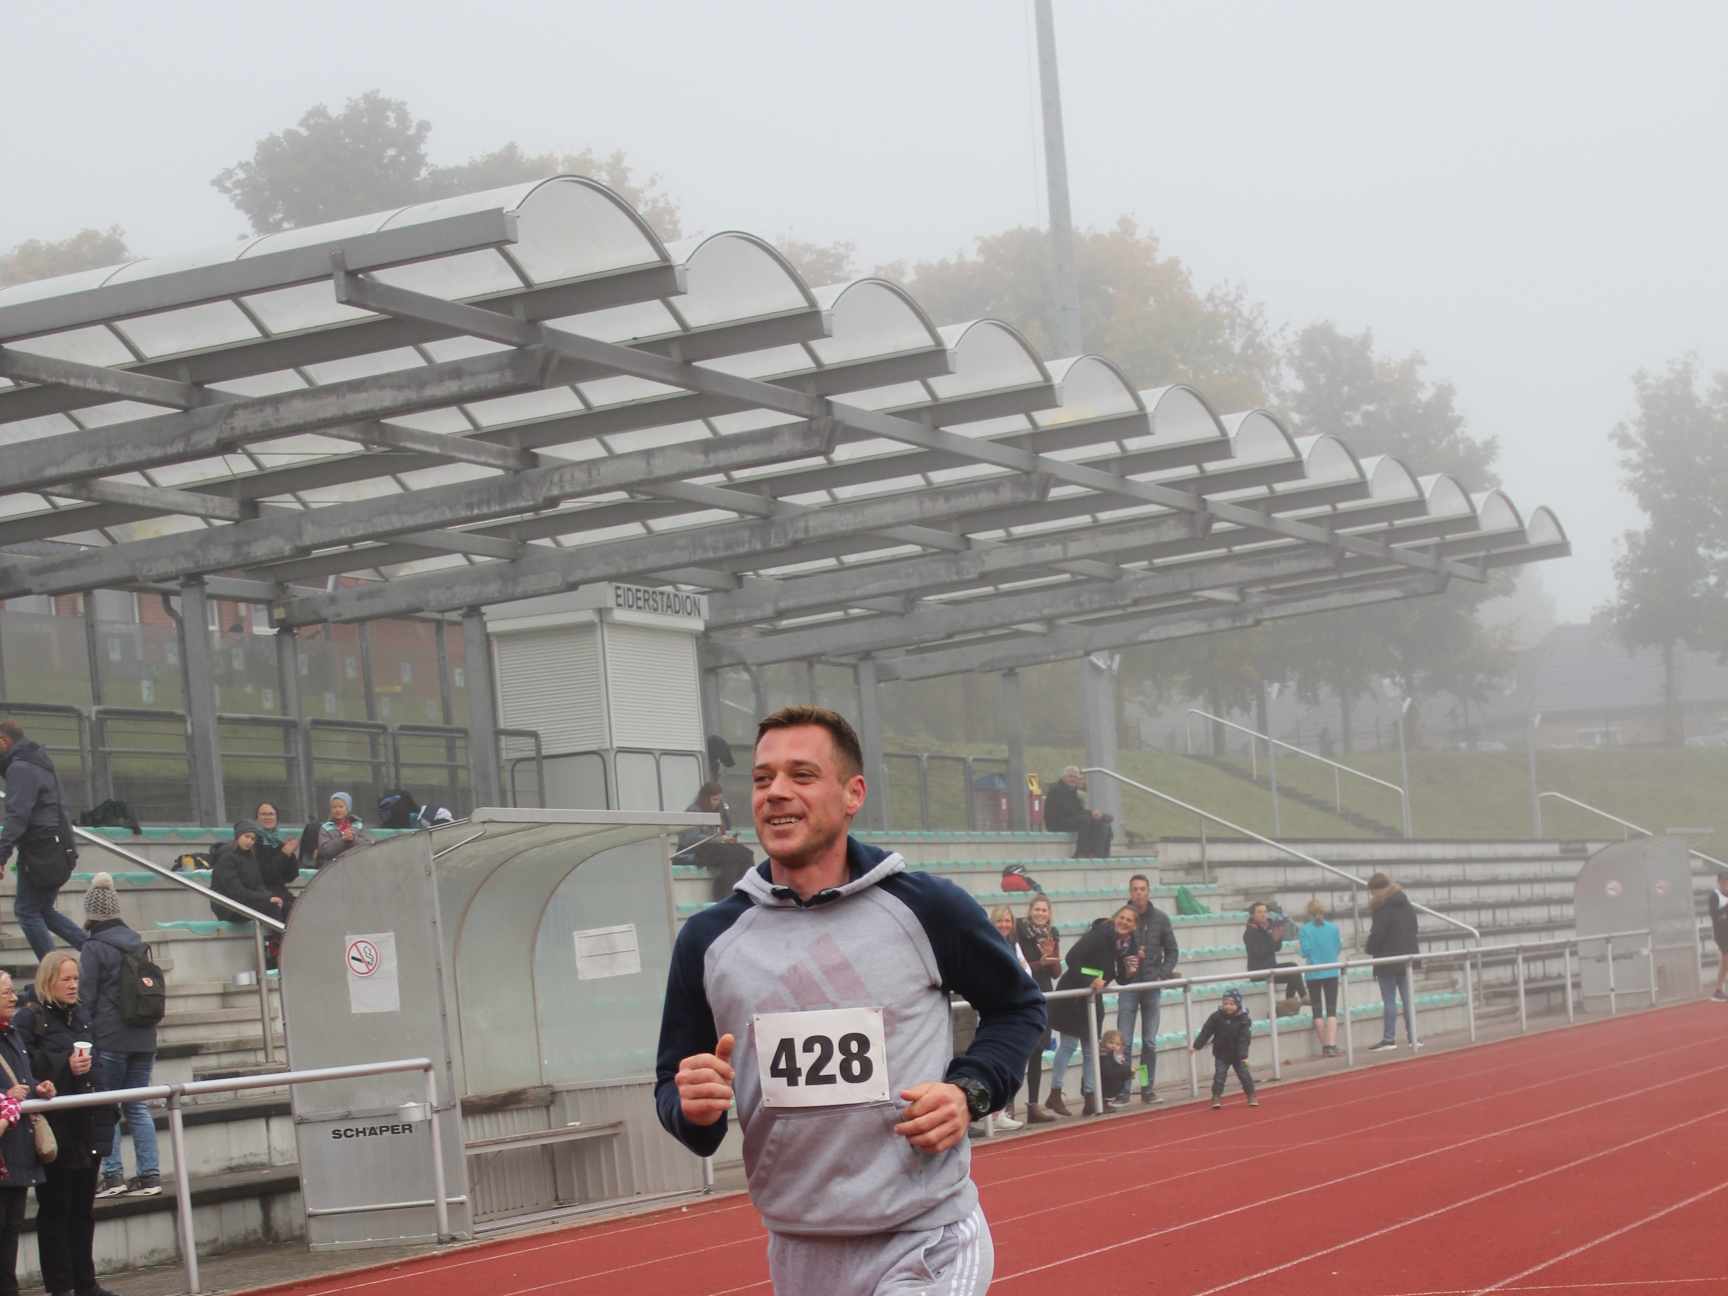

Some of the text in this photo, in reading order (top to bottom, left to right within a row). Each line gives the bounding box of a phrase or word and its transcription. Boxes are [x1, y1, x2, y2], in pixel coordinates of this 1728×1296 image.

[615, 586, 701, 616] EIDERSTADION
[770, 1032, 873, 1087] 428
[331, 1123, 413, 1139] SCHÄPER
